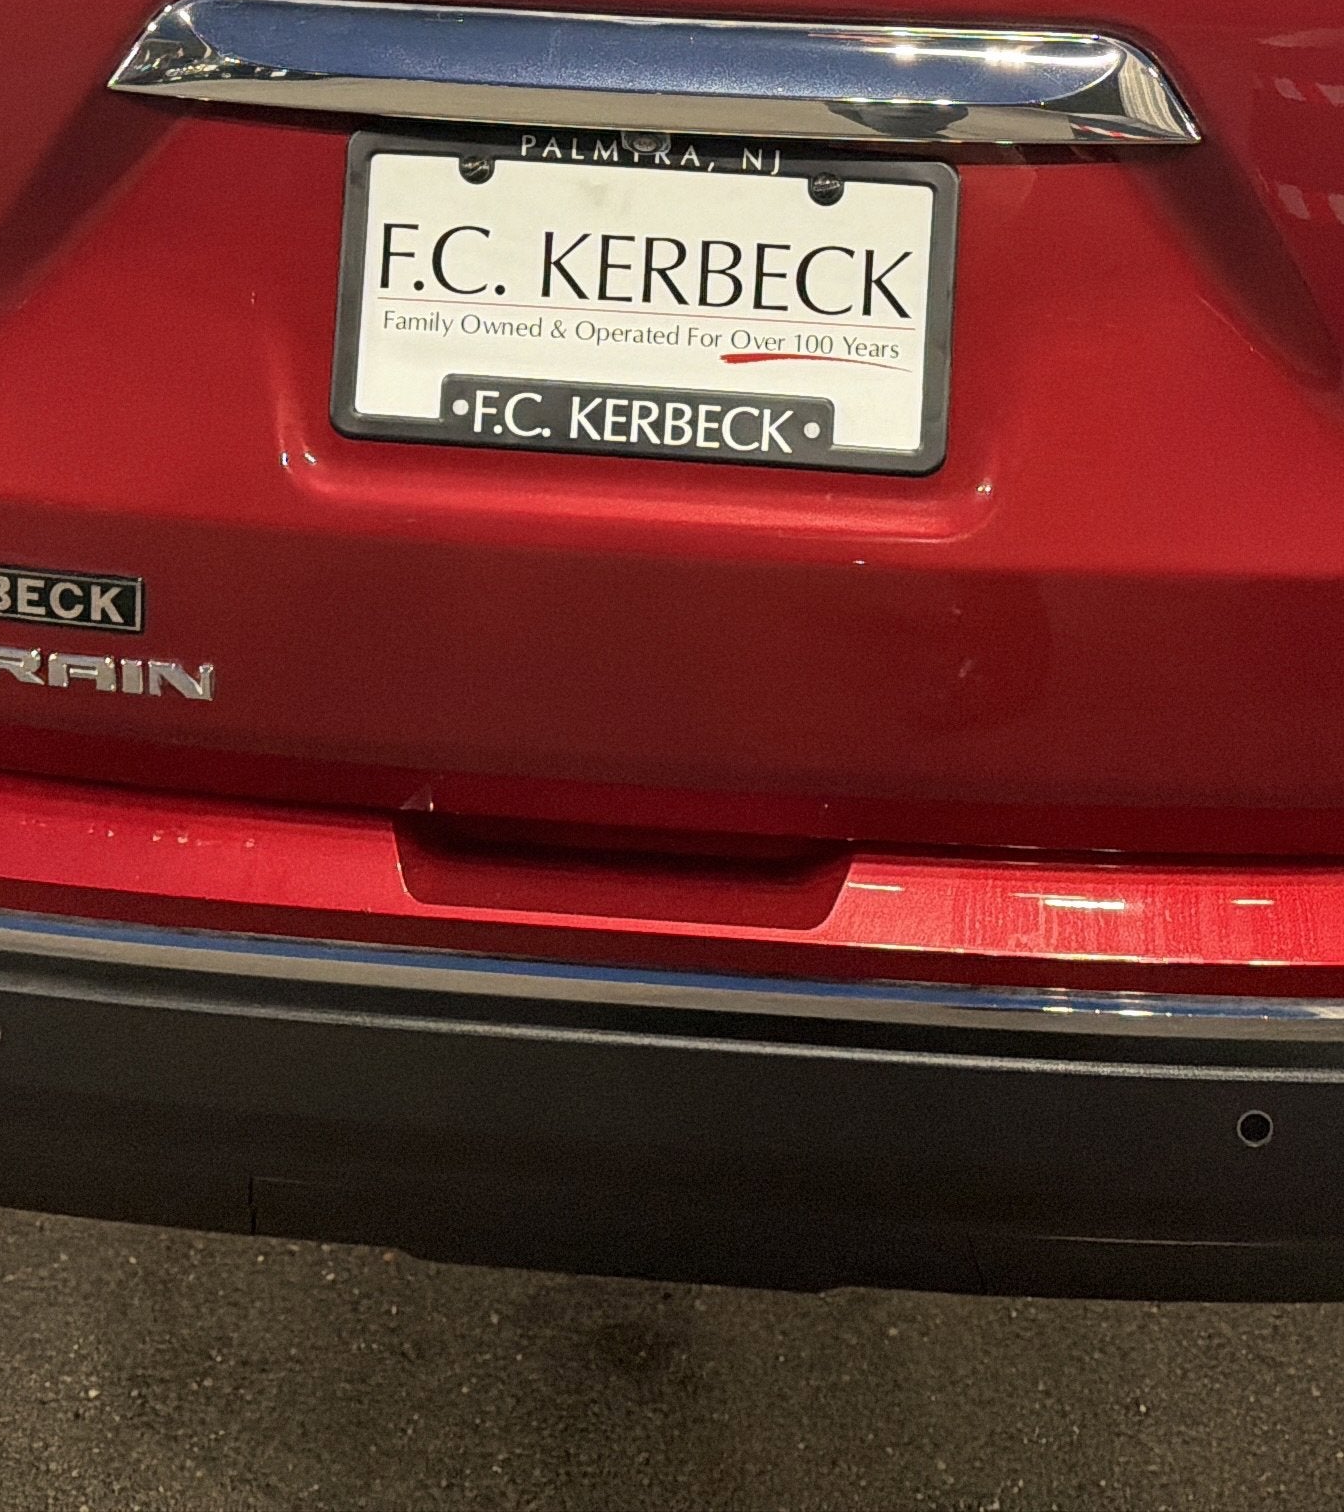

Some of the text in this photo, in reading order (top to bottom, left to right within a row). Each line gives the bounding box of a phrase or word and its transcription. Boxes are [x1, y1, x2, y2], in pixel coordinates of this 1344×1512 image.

[742, 147, 781, 176] NJ
[379, 222, 914, 319] F.C. KERBECK
[383, 309, 900, 360] Family Owned & Operated For Over 100 Years
[472, 389, 794, 454] F.C. KERBECK
